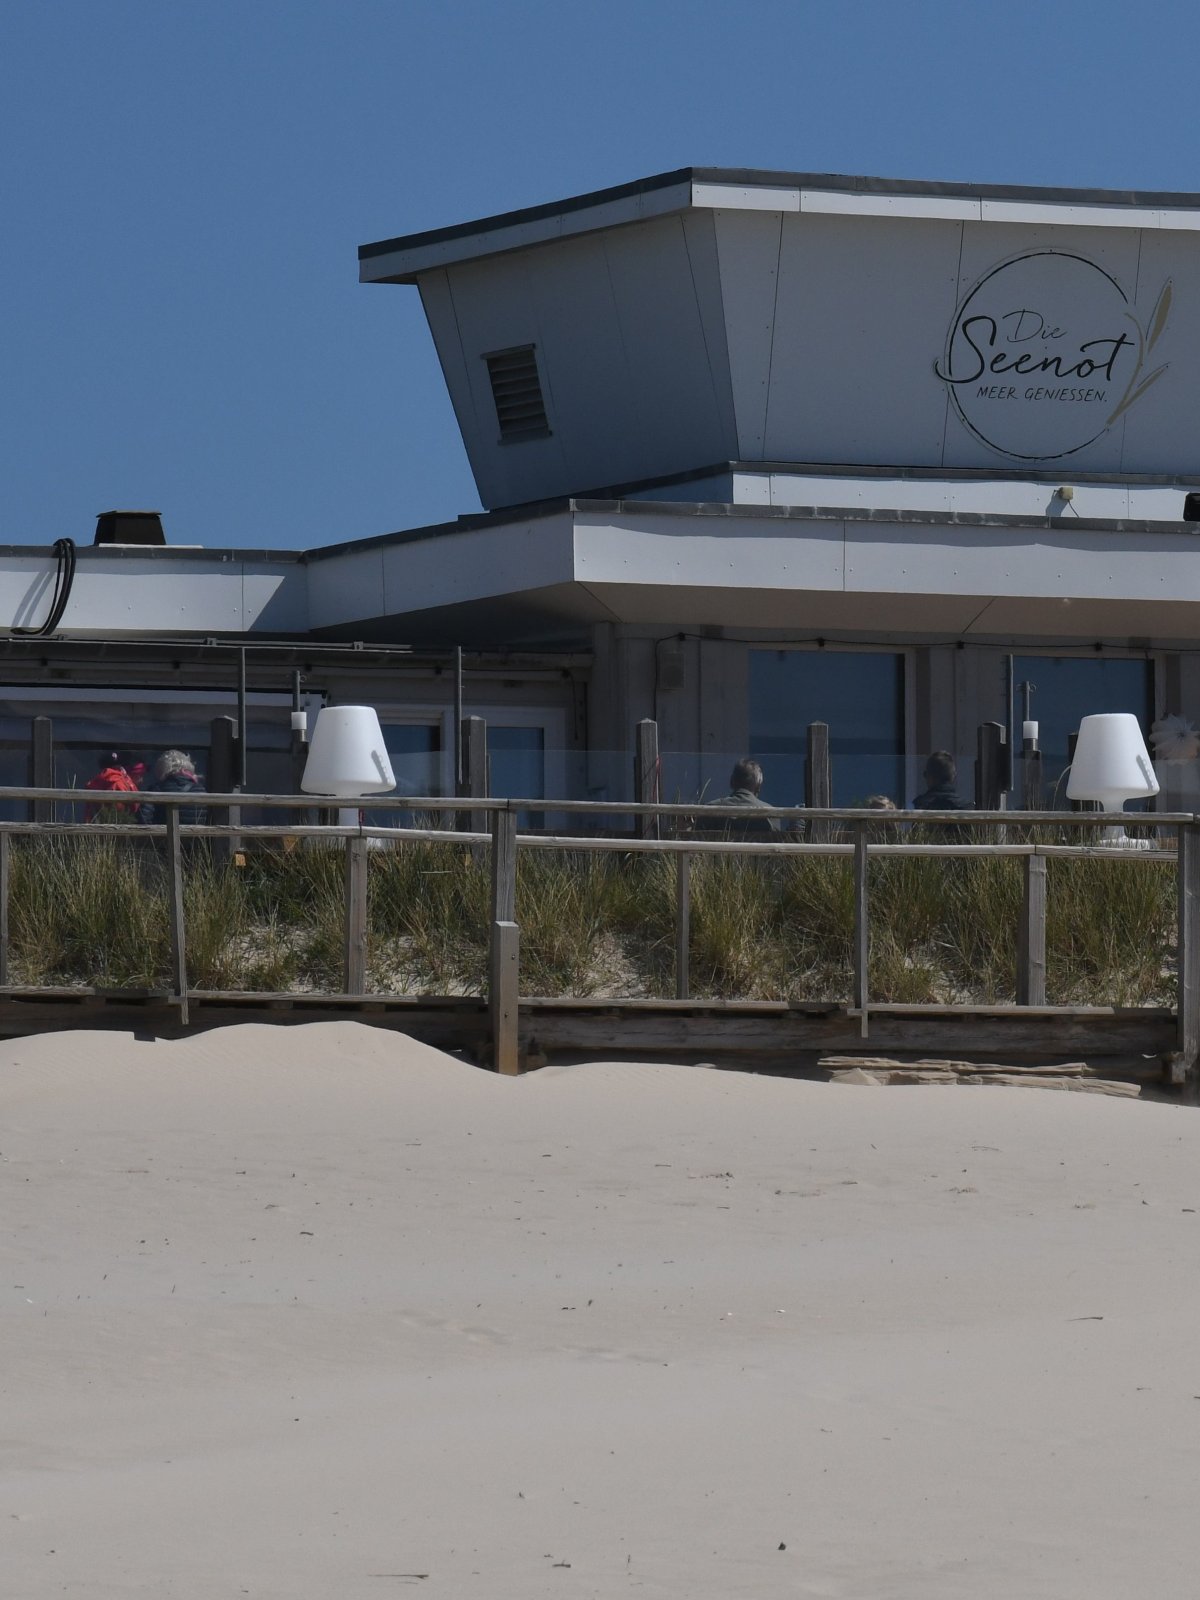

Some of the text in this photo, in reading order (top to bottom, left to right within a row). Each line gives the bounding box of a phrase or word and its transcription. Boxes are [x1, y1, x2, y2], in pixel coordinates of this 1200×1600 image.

[1002, 308, 1069, 342] Die
[934, 315, 1135, 384] Seenot
[976, 386, 1107, 402] MEER GENIESSEN.
